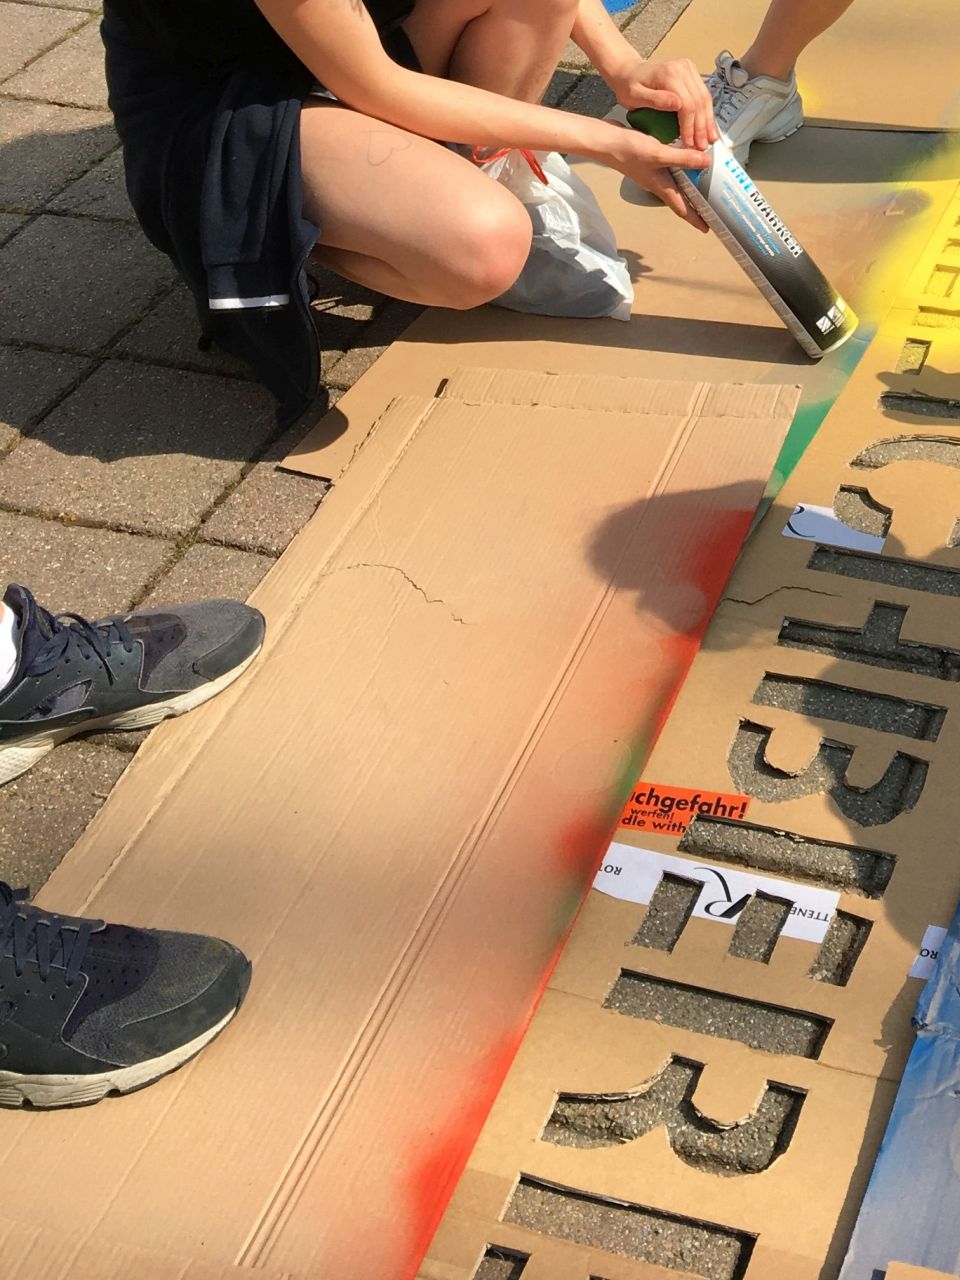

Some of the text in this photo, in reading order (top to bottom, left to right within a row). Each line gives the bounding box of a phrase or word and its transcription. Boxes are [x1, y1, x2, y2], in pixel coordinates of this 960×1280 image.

[724, 157, 803, 258] LINEMARKER
[630, 807, 675, 821] werfen!
[652, 821, 687, 833] with
